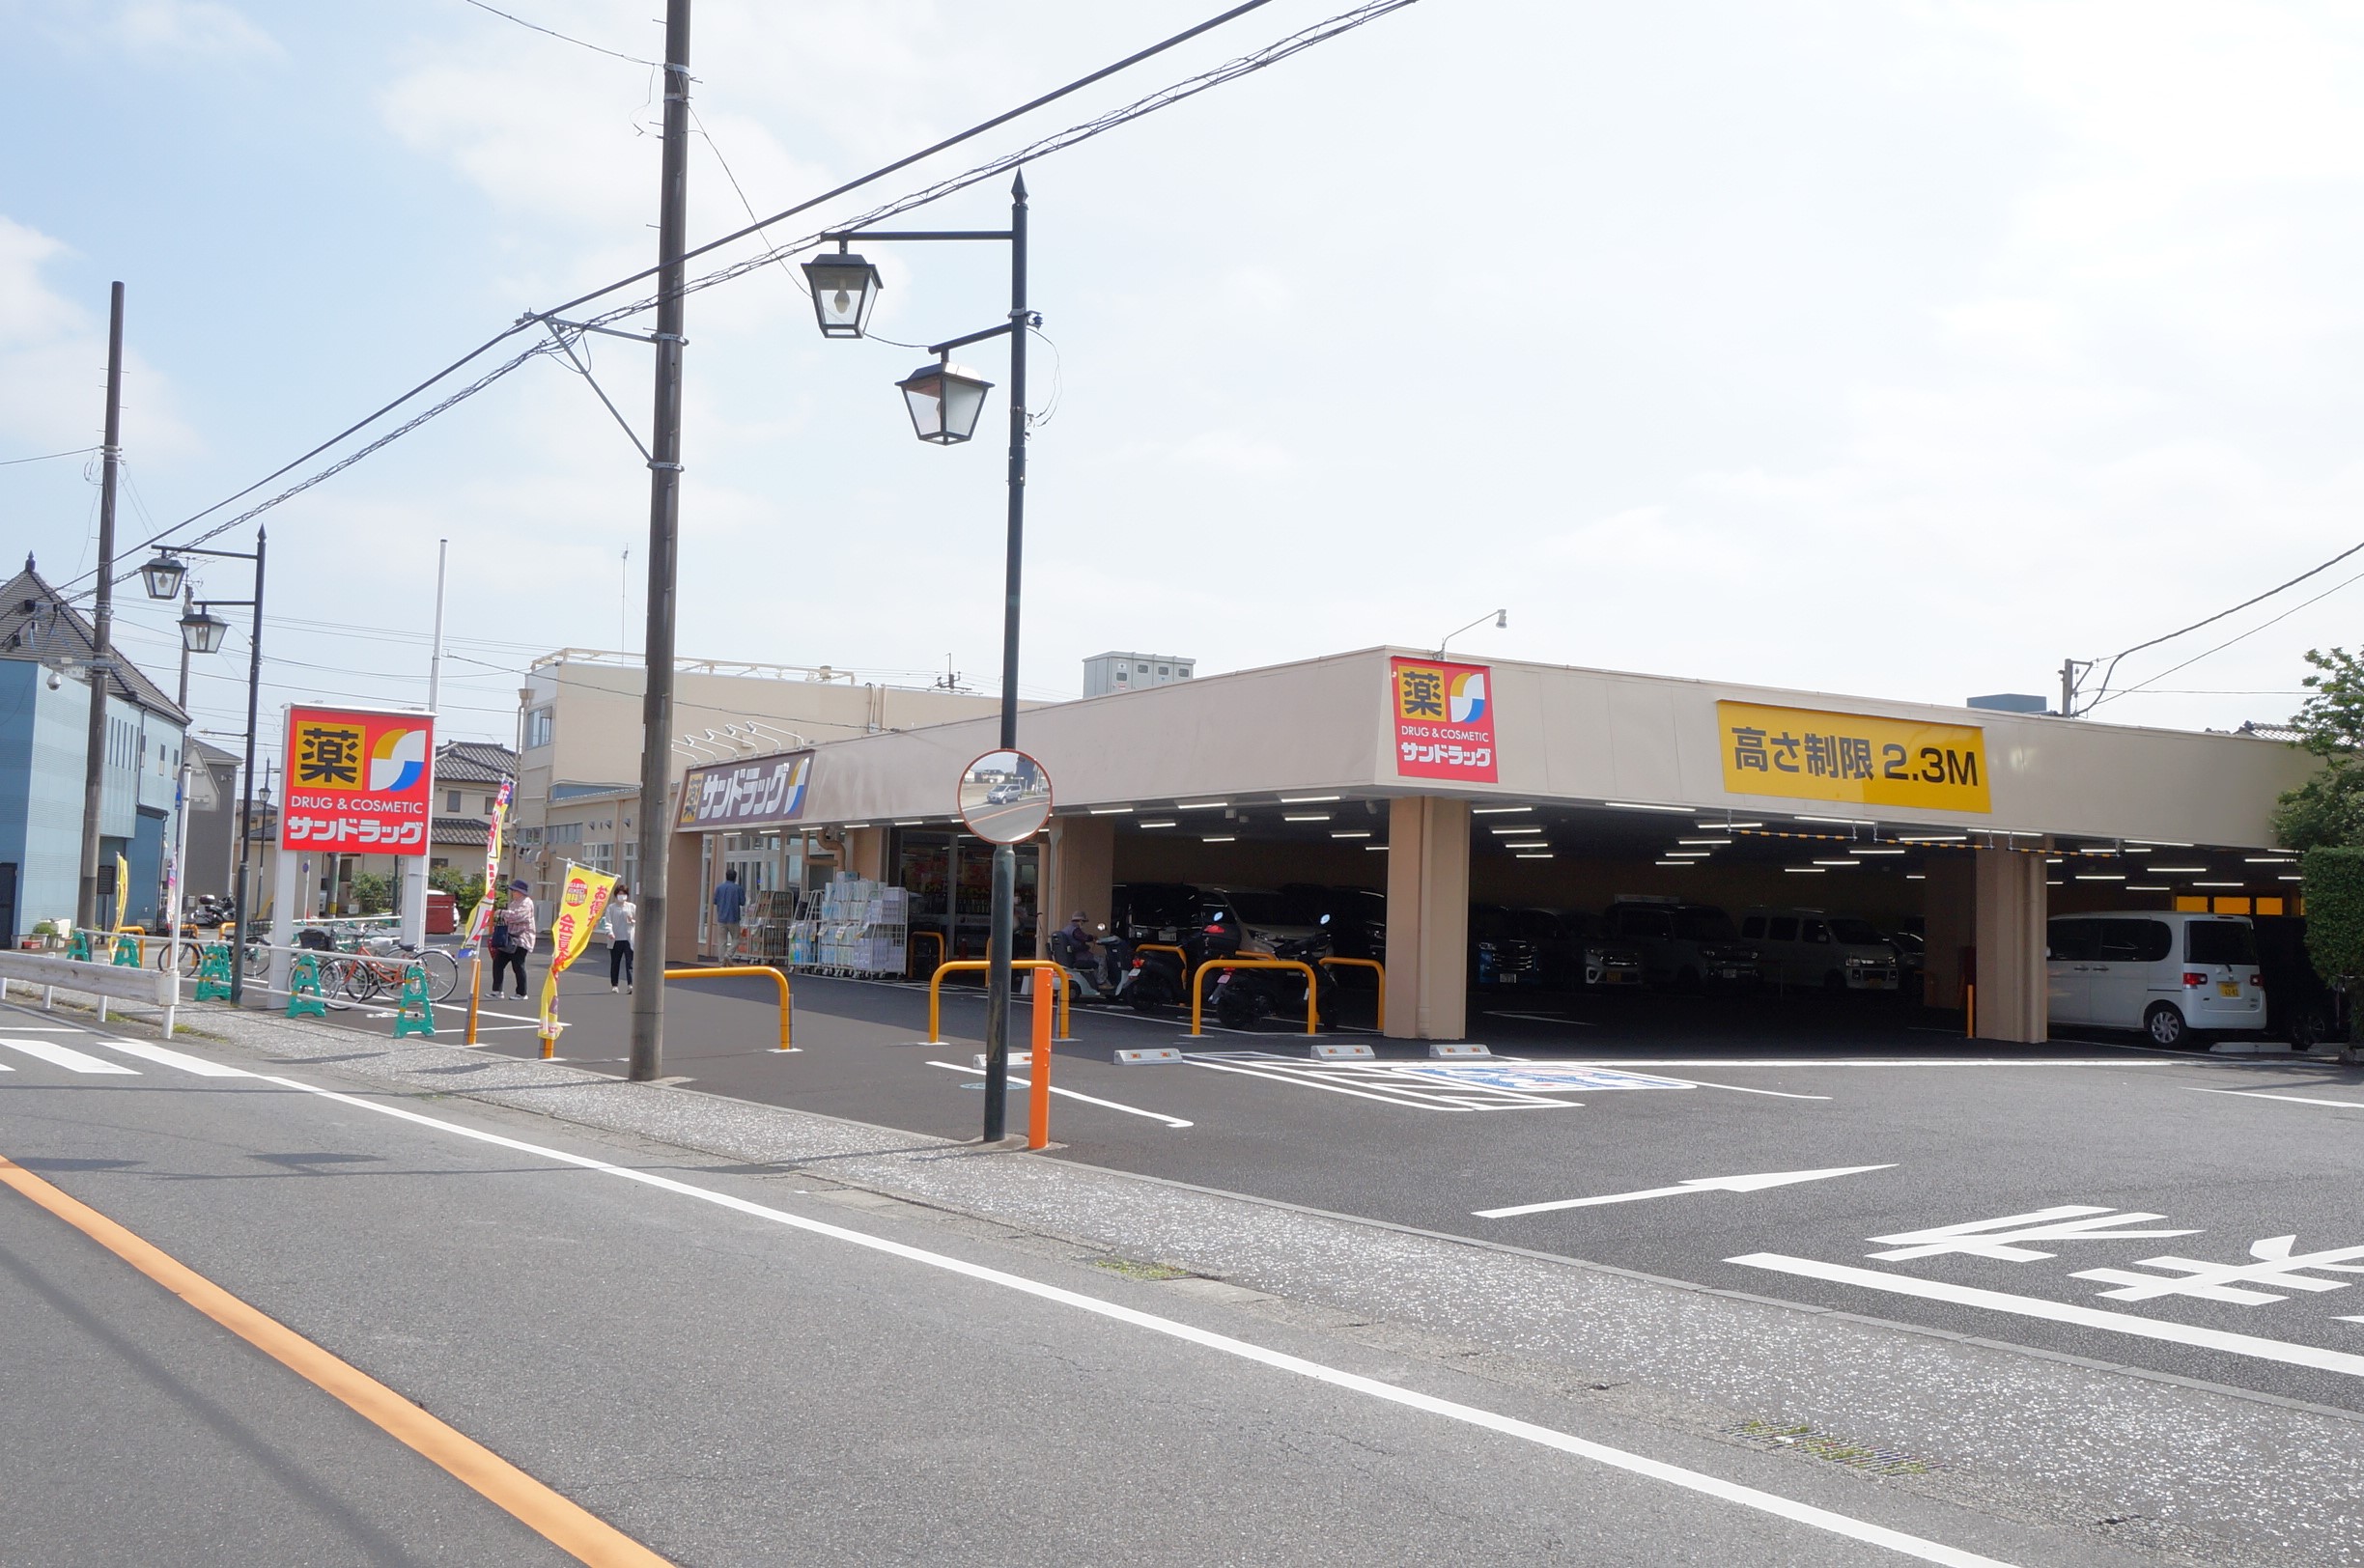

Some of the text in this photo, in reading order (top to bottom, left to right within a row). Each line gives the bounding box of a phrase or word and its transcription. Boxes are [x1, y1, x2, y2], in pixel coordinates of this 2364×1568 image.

[1402, 671, 1443, 717] 薬
[1401, 725, 1489, 742] DRUG & COSMETIC
[300, 728, 358, 784] 薬
[1401, 742, 1491, 767] サンドラッグ
[1731, 726, 1979, 787] 高さ制限 2.3M
[292, 796, 423, 814] DRUG & COSMETIC
[682, 763, 790, 820] 薬 サンドラッグ
[288, 816, 424, 845] サンドラッグ
